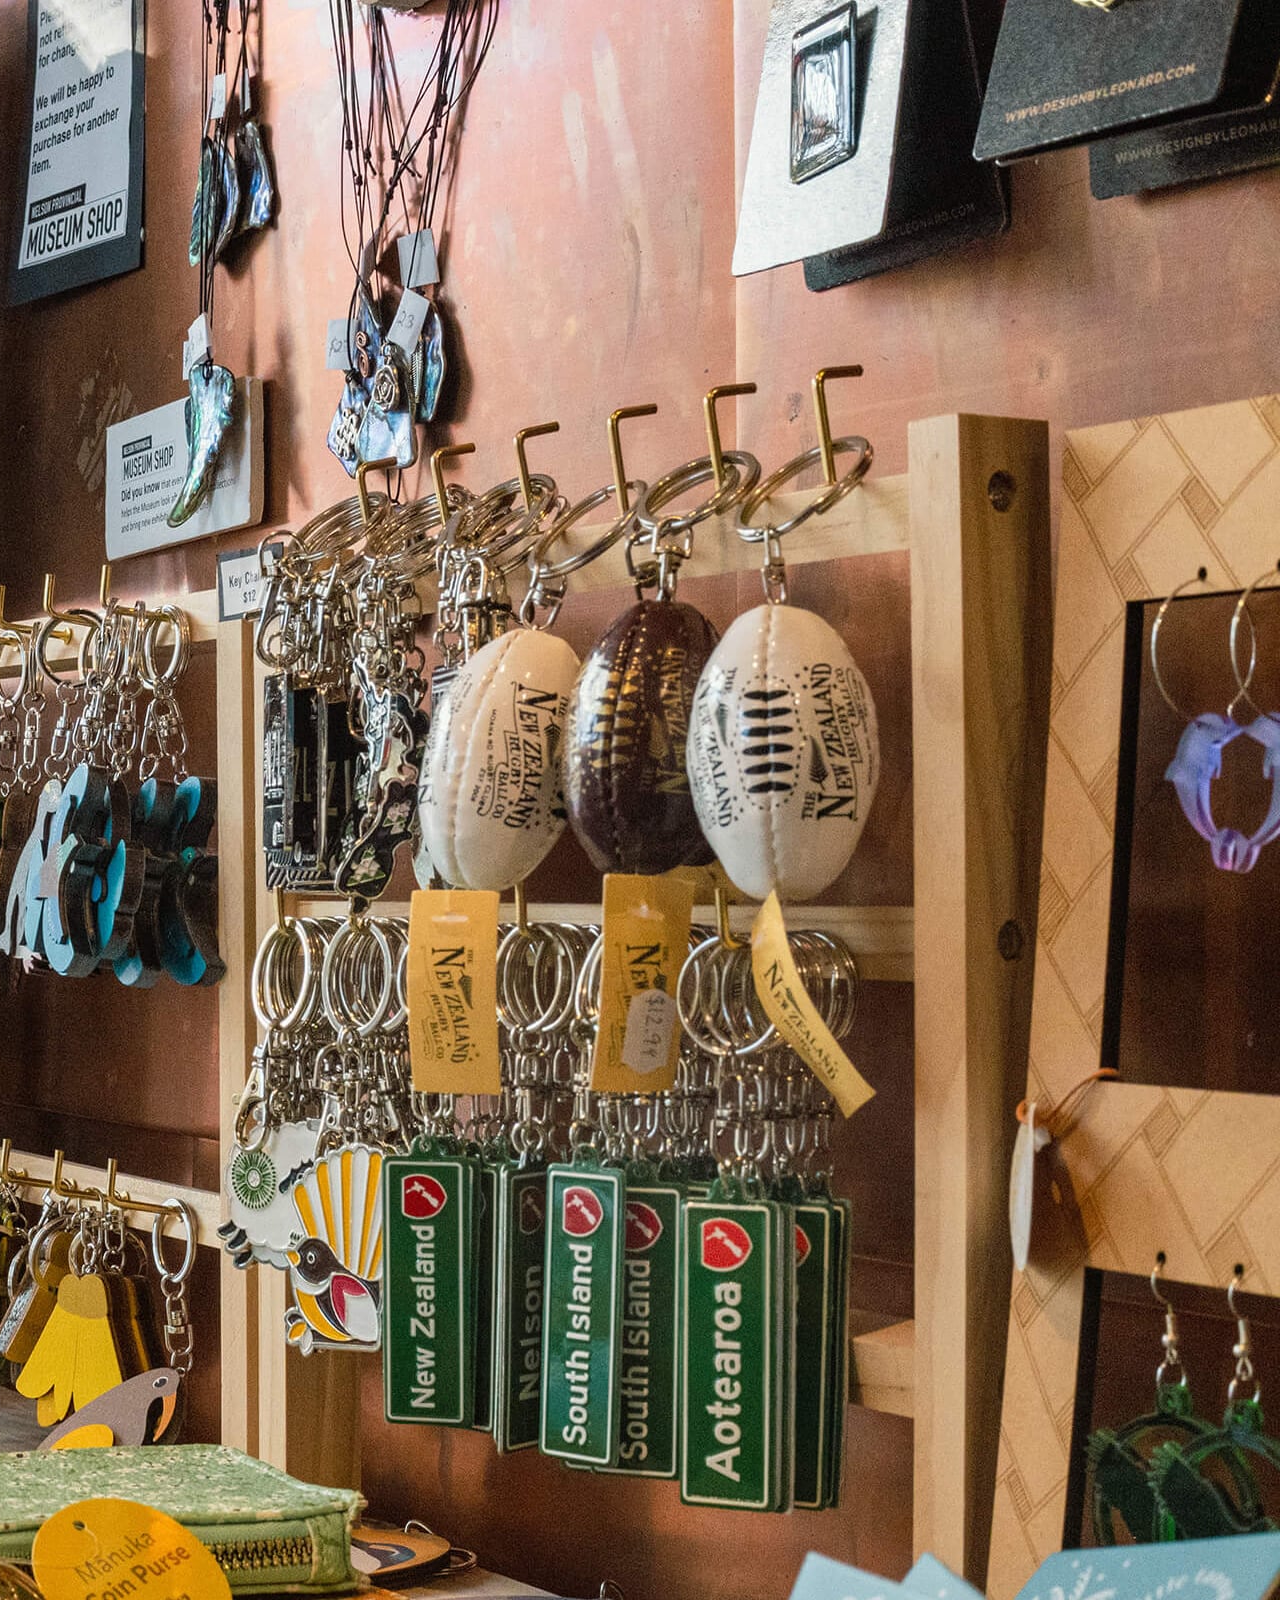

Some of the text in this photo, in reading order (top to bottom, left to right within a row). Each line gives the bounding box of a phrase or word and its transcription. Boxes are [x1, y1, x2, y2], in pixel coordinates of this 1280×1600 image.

[38, 52, 50, 69] for
[39, 30, 53, 48] not
[35, 65, 115, 113] We will be happy to
[1005, 63, 1196, 124] WWW.DESIGNBYLEONARD.COM
[32, 107, 119, 157] purchase for another
[34, 96, 95, 133] exchange your
[1114, 117, 1280, 164] WWW.DESIGNBYLEONAR
[31, 158, 52, 176] item.
[26, 199, 123, 260] MUSEUM SHOP
[123, 452, 153, 480] MUSEUM
[154, 445, 174, 470] SHOP
[121, 487, 131, 502] Did
[131, 487, 143, 501] you
[143, 481, 160, 496] know
[228, 575, 242, 589] Key
[242, 589, 257, 603] $12
[840, 687, 857, 719] BALL
[810, 663, 855, 821] NEW ZEALAND
[835, 703, 858, 758] RUGBY
[504, 683, 559, 828] NEW ZEALAND
[509, 736, 521, 789] RUGBY
[706, 731, 732, 828] ZEALAND
[496, 770, 510, 802] BALL
[801, 790, 817, 821] THE
[626, 942, 661, 990] NEW
[430, 994, 449, 1032] RUGBY
[431, 946, 471, 1063] NEW ZEALAND
[788, 1011, 837, 1080] ZEALAND
[410, 1225, 436, 1408] New Zealand
[520, 1265, 541, 1400] Nelson
[562, 1243, 593, 1446] South Island
[620, 1259, 651, 1461] South Island
[705, 1281, 742, 1483] Aotearoa
[130, 1546, 191, 1585] Purse
